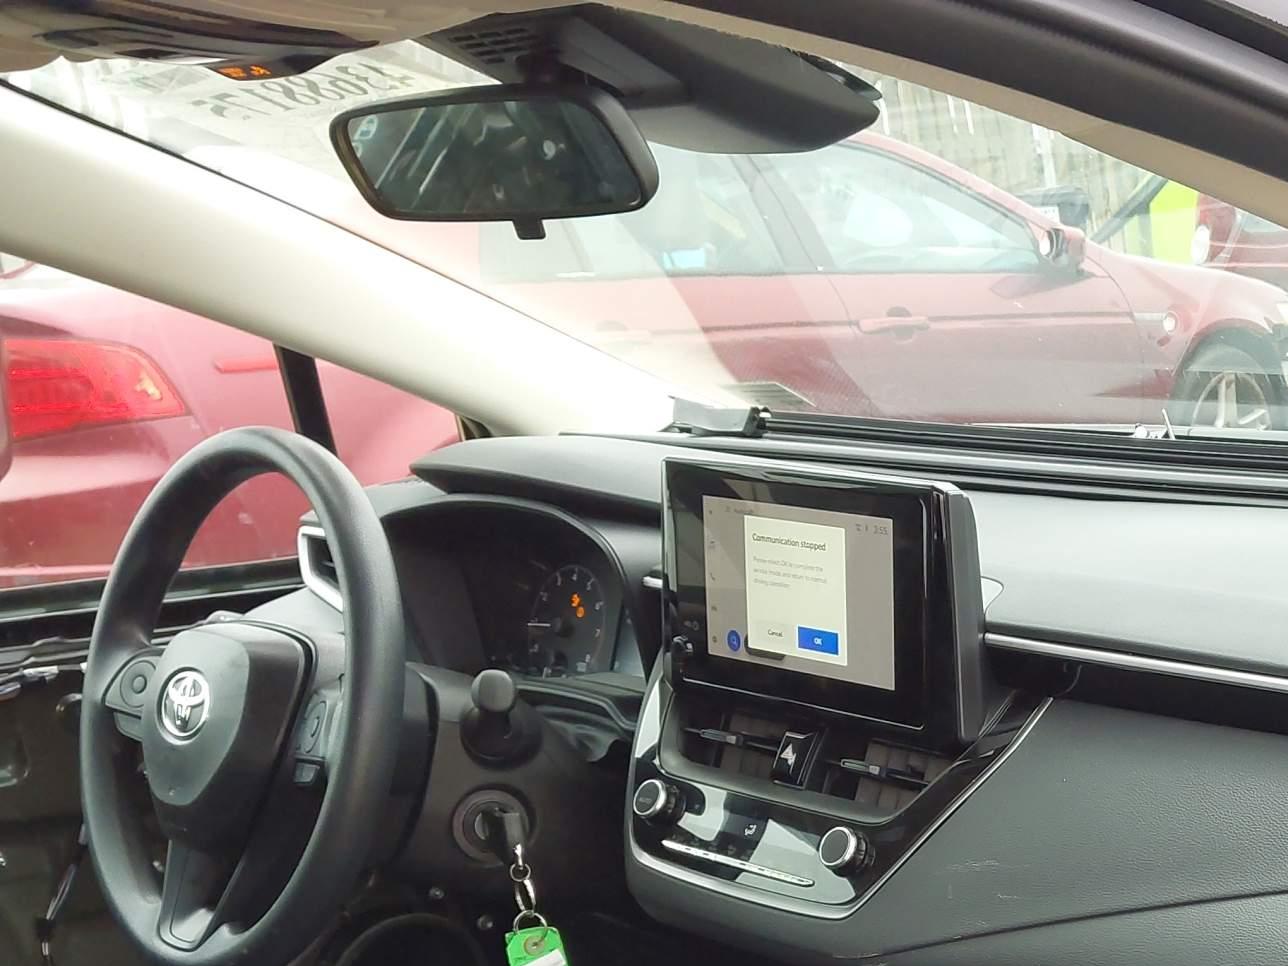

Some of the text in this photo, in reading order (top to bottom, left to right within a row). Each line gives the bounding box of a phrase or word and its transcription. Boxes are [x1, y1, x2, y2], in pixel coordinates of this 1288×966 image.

[752, 533, 826, 551] Communication stopped
[768, 629, 823, 646] Cancel OK
